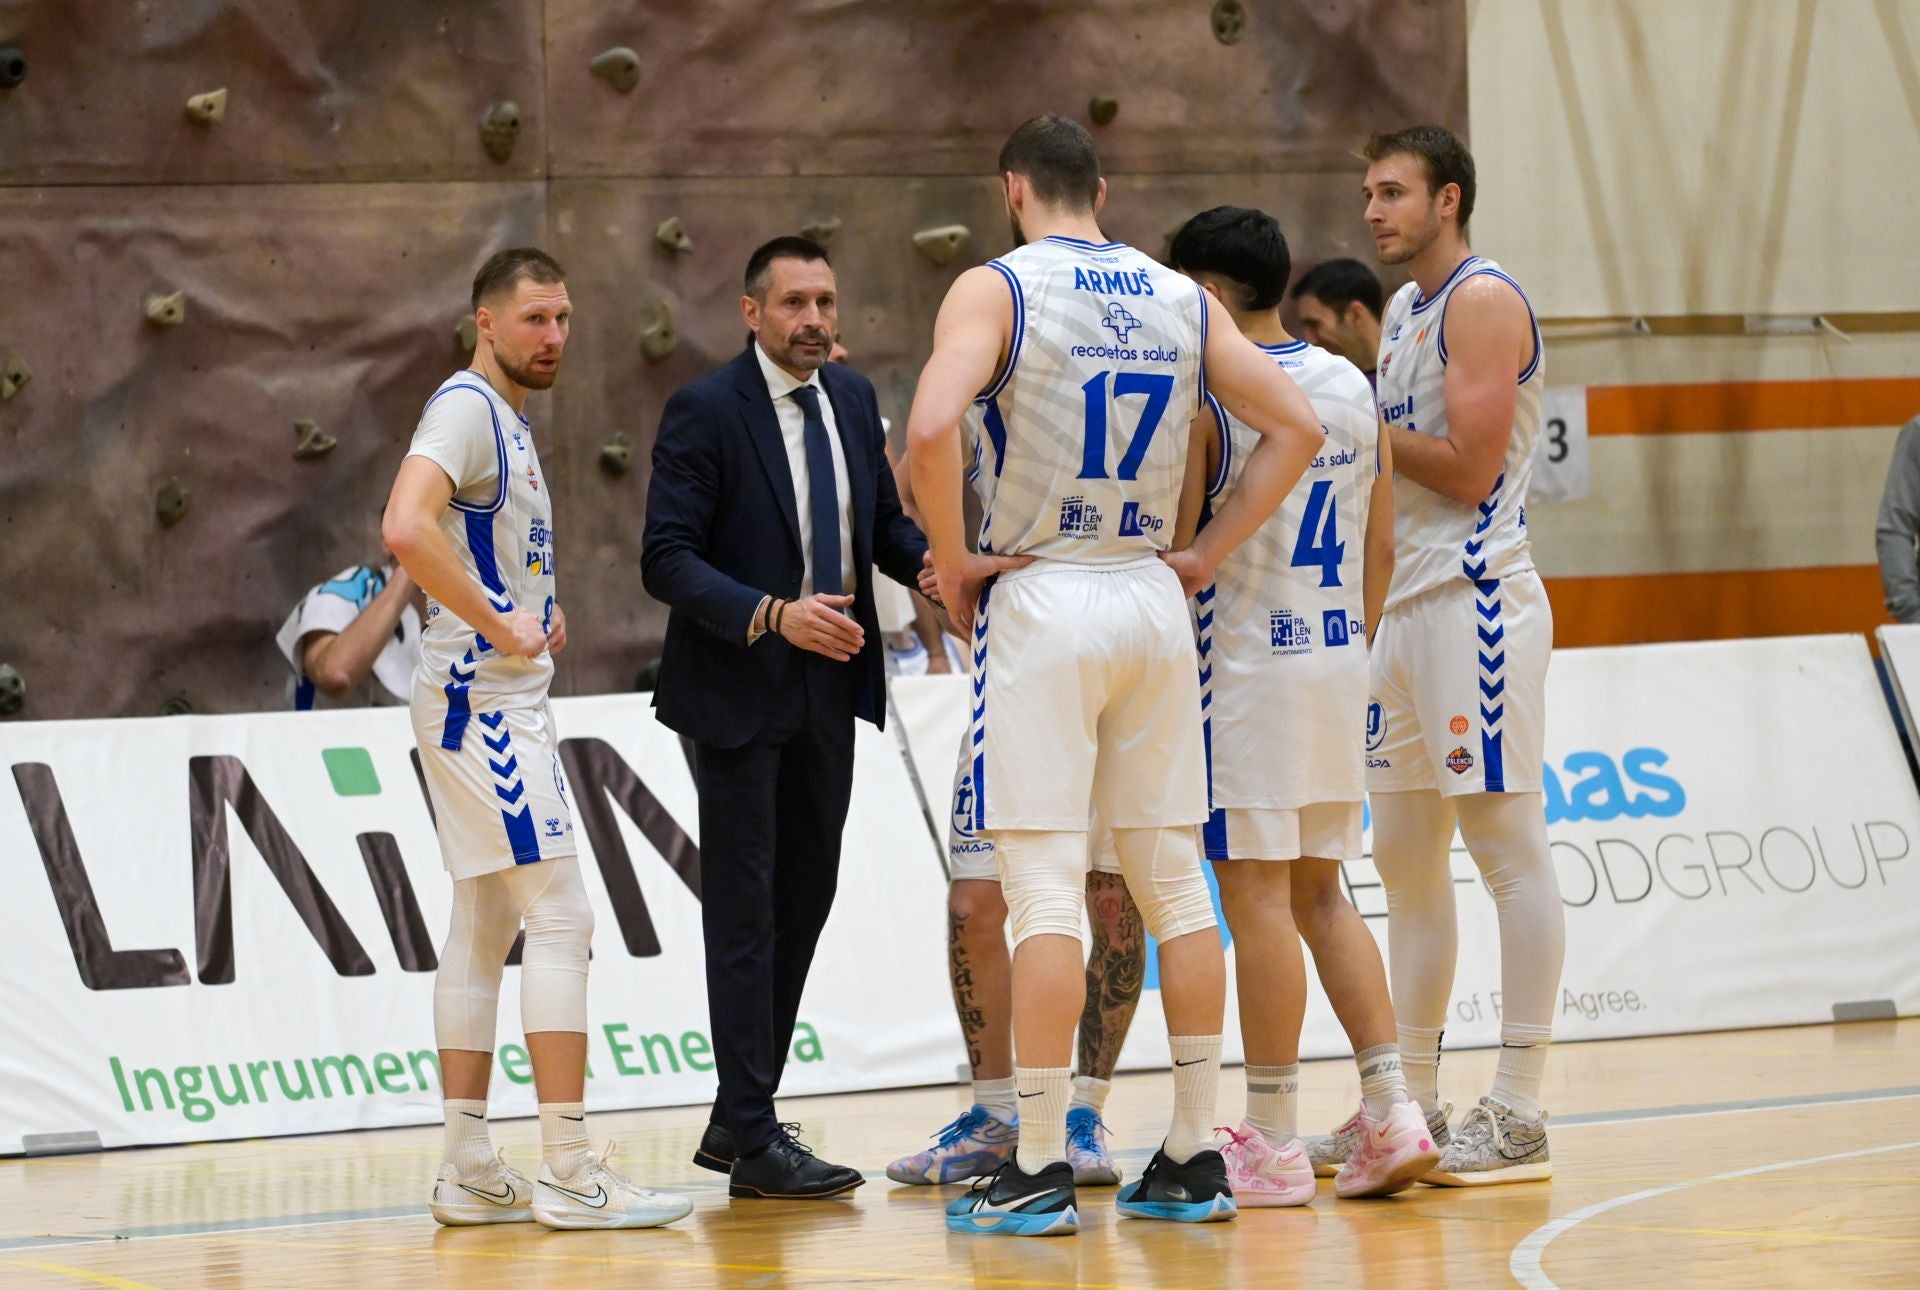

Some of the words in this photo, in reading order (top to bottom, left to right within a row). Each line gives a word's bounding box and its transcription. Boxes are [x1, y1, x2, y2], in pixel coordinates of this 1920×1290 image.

[1074, 267, 1154, 297] ARMUŠ
[1071, 343, 1137, 361] recoletas
[1143, 344, 1178, 362] salud
[1076, 370, 1175, 481] 17
[1547, 418, 1569, 464] 3
[1084, 504, 1098, 514] PA
[1082, 523, 1098, 533] CIA
[1083, 514, 1103, 524] LEN
[1139, 514, 1164, 532] Dip
[1290, 480, 1346, 587] 4
[1294, 617, 1305, 627] PA
[1294, 626, 1311, 636] LEN
[1295, 636, 1310, 646] CIA
[1562, 986, 1648, 1021] Agree.
[108, 1048, 443, 1122] Ingurumen
[602, 1020, 825, 1077] Enea
